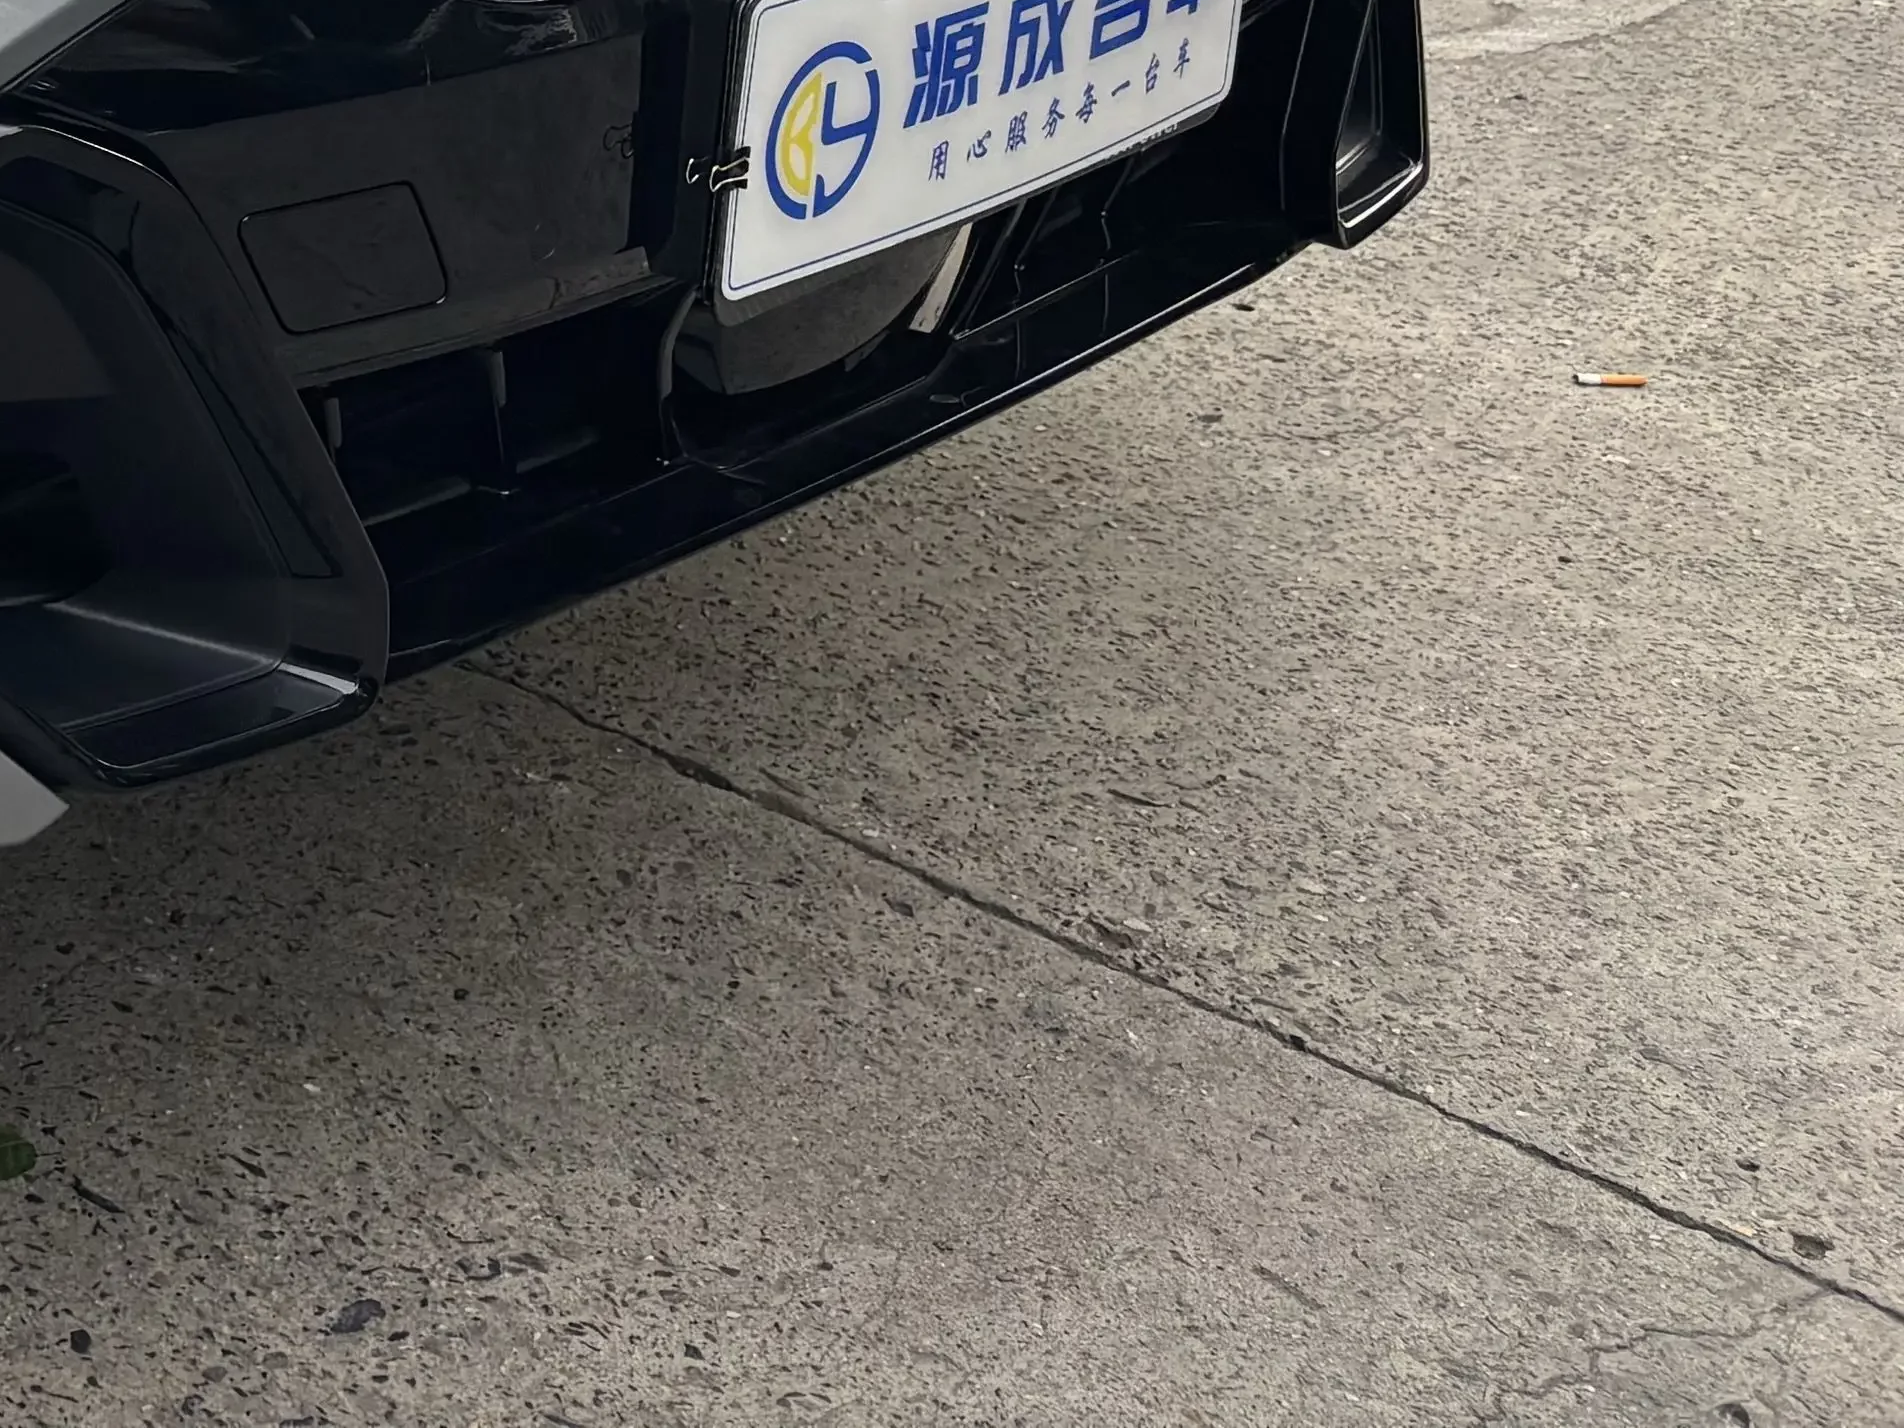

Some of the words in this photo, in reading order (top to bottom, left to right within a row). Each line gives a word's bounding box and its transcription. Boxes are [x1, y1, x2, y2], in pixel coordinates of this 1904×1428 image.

[927, 35, 1192, 182] 用心服务每一台车
